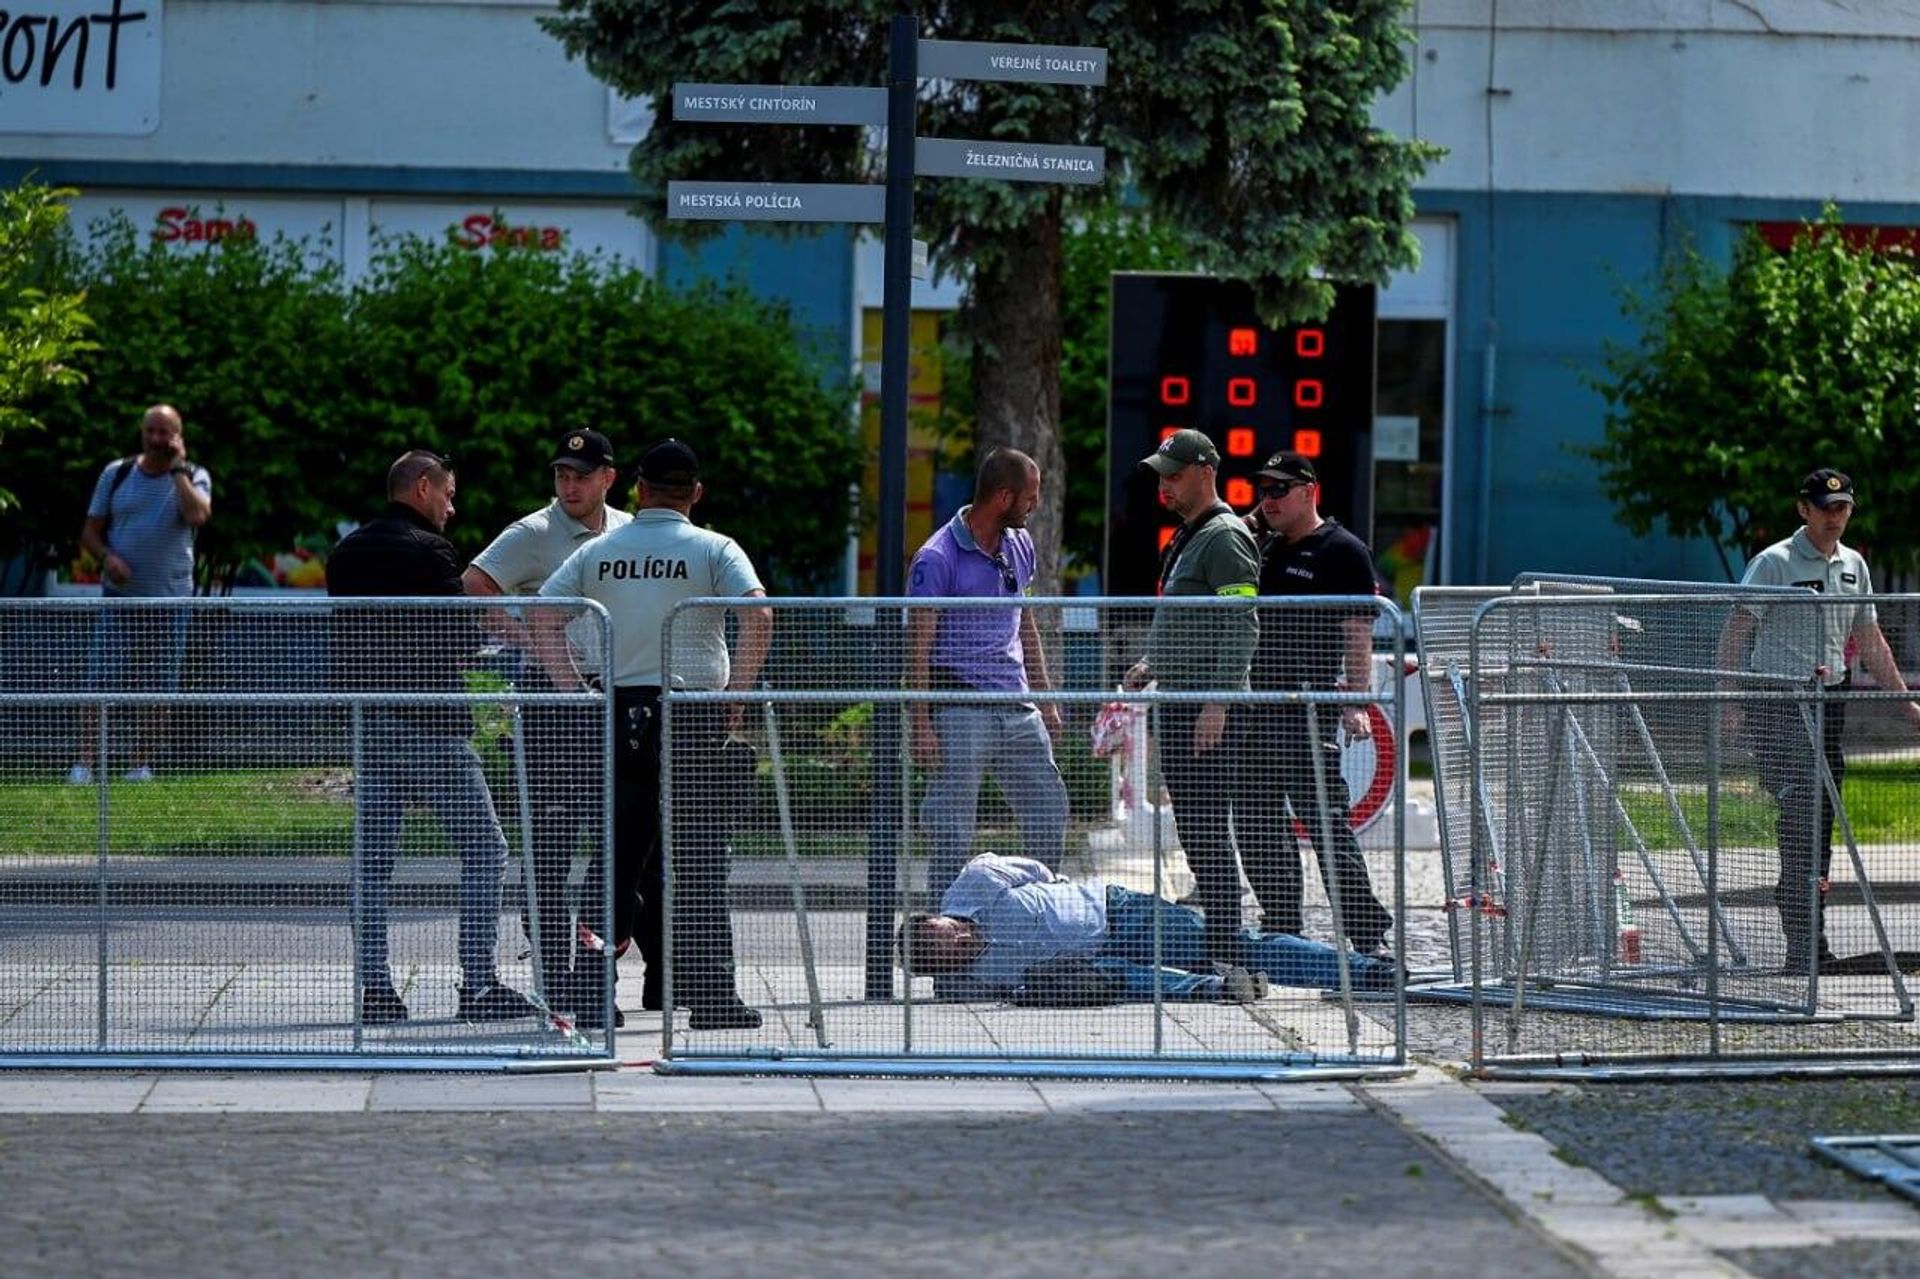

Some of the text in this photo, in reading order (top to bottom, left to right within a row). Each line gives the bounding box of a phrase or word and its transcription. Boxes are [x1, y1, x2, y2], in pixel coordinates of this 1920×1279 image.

[0, 0, 147, 90] ont
[990, 55, 1097, 73] VEREJNÉ TOALETY
[684, 94, 816, 111] MESTSKÝ CINTORÍN
[966, 150, 1095, 172] ŽELEZNIČNÁ STANICA
[680, 192, 802, 208] MESTSKÁ POLÍCIA
[599, 555, 688, 581] POLÍCIA
